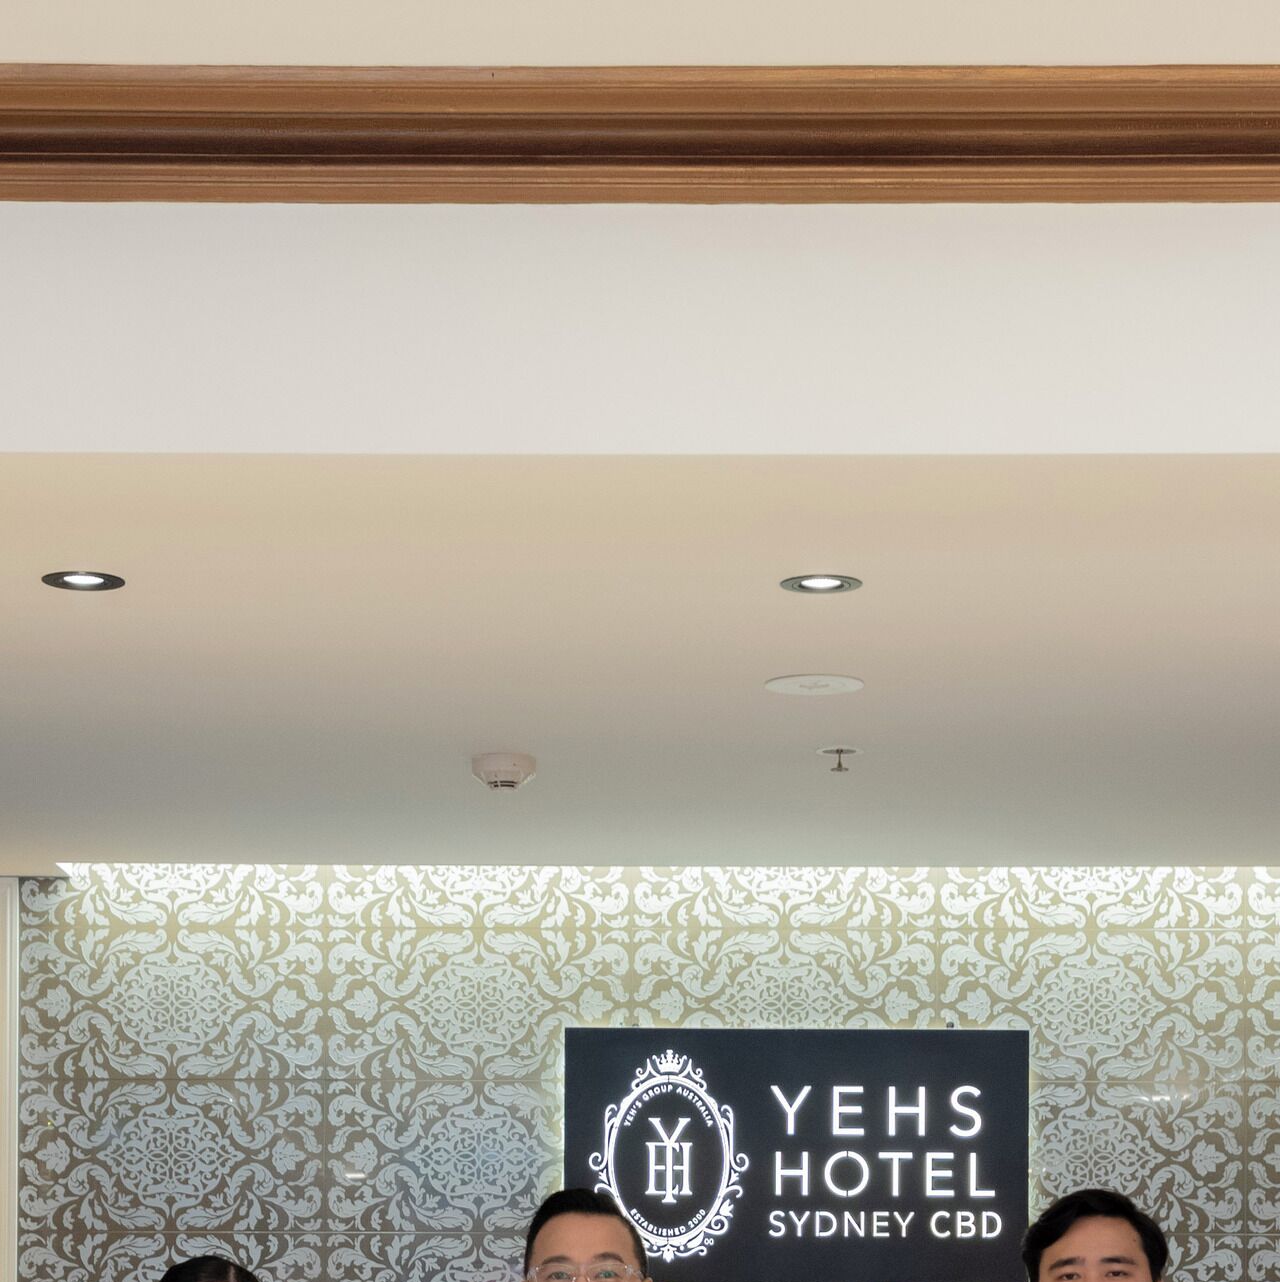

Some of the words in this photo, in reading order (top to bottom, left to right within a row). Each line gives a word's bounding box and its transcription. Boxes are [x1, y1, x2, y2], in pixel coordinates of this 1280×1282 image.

[623, 1100, 643, 1127] YEH'S
[642, 1084, 673, 1102] GROUP
[676, 1086, 714, 1128] AUSTRALIA
[770, 1085, 983, 1138] YEHS
[775, 1149, 996, 1198] HOTEL
[630, 1208, 686, 1236] ESTABLISHED
[687, 1208, 706, 1228] 2000
[768, 1210, 915, 1238] SYDNEY
[929, 1210, 1003, 1239] CBD
